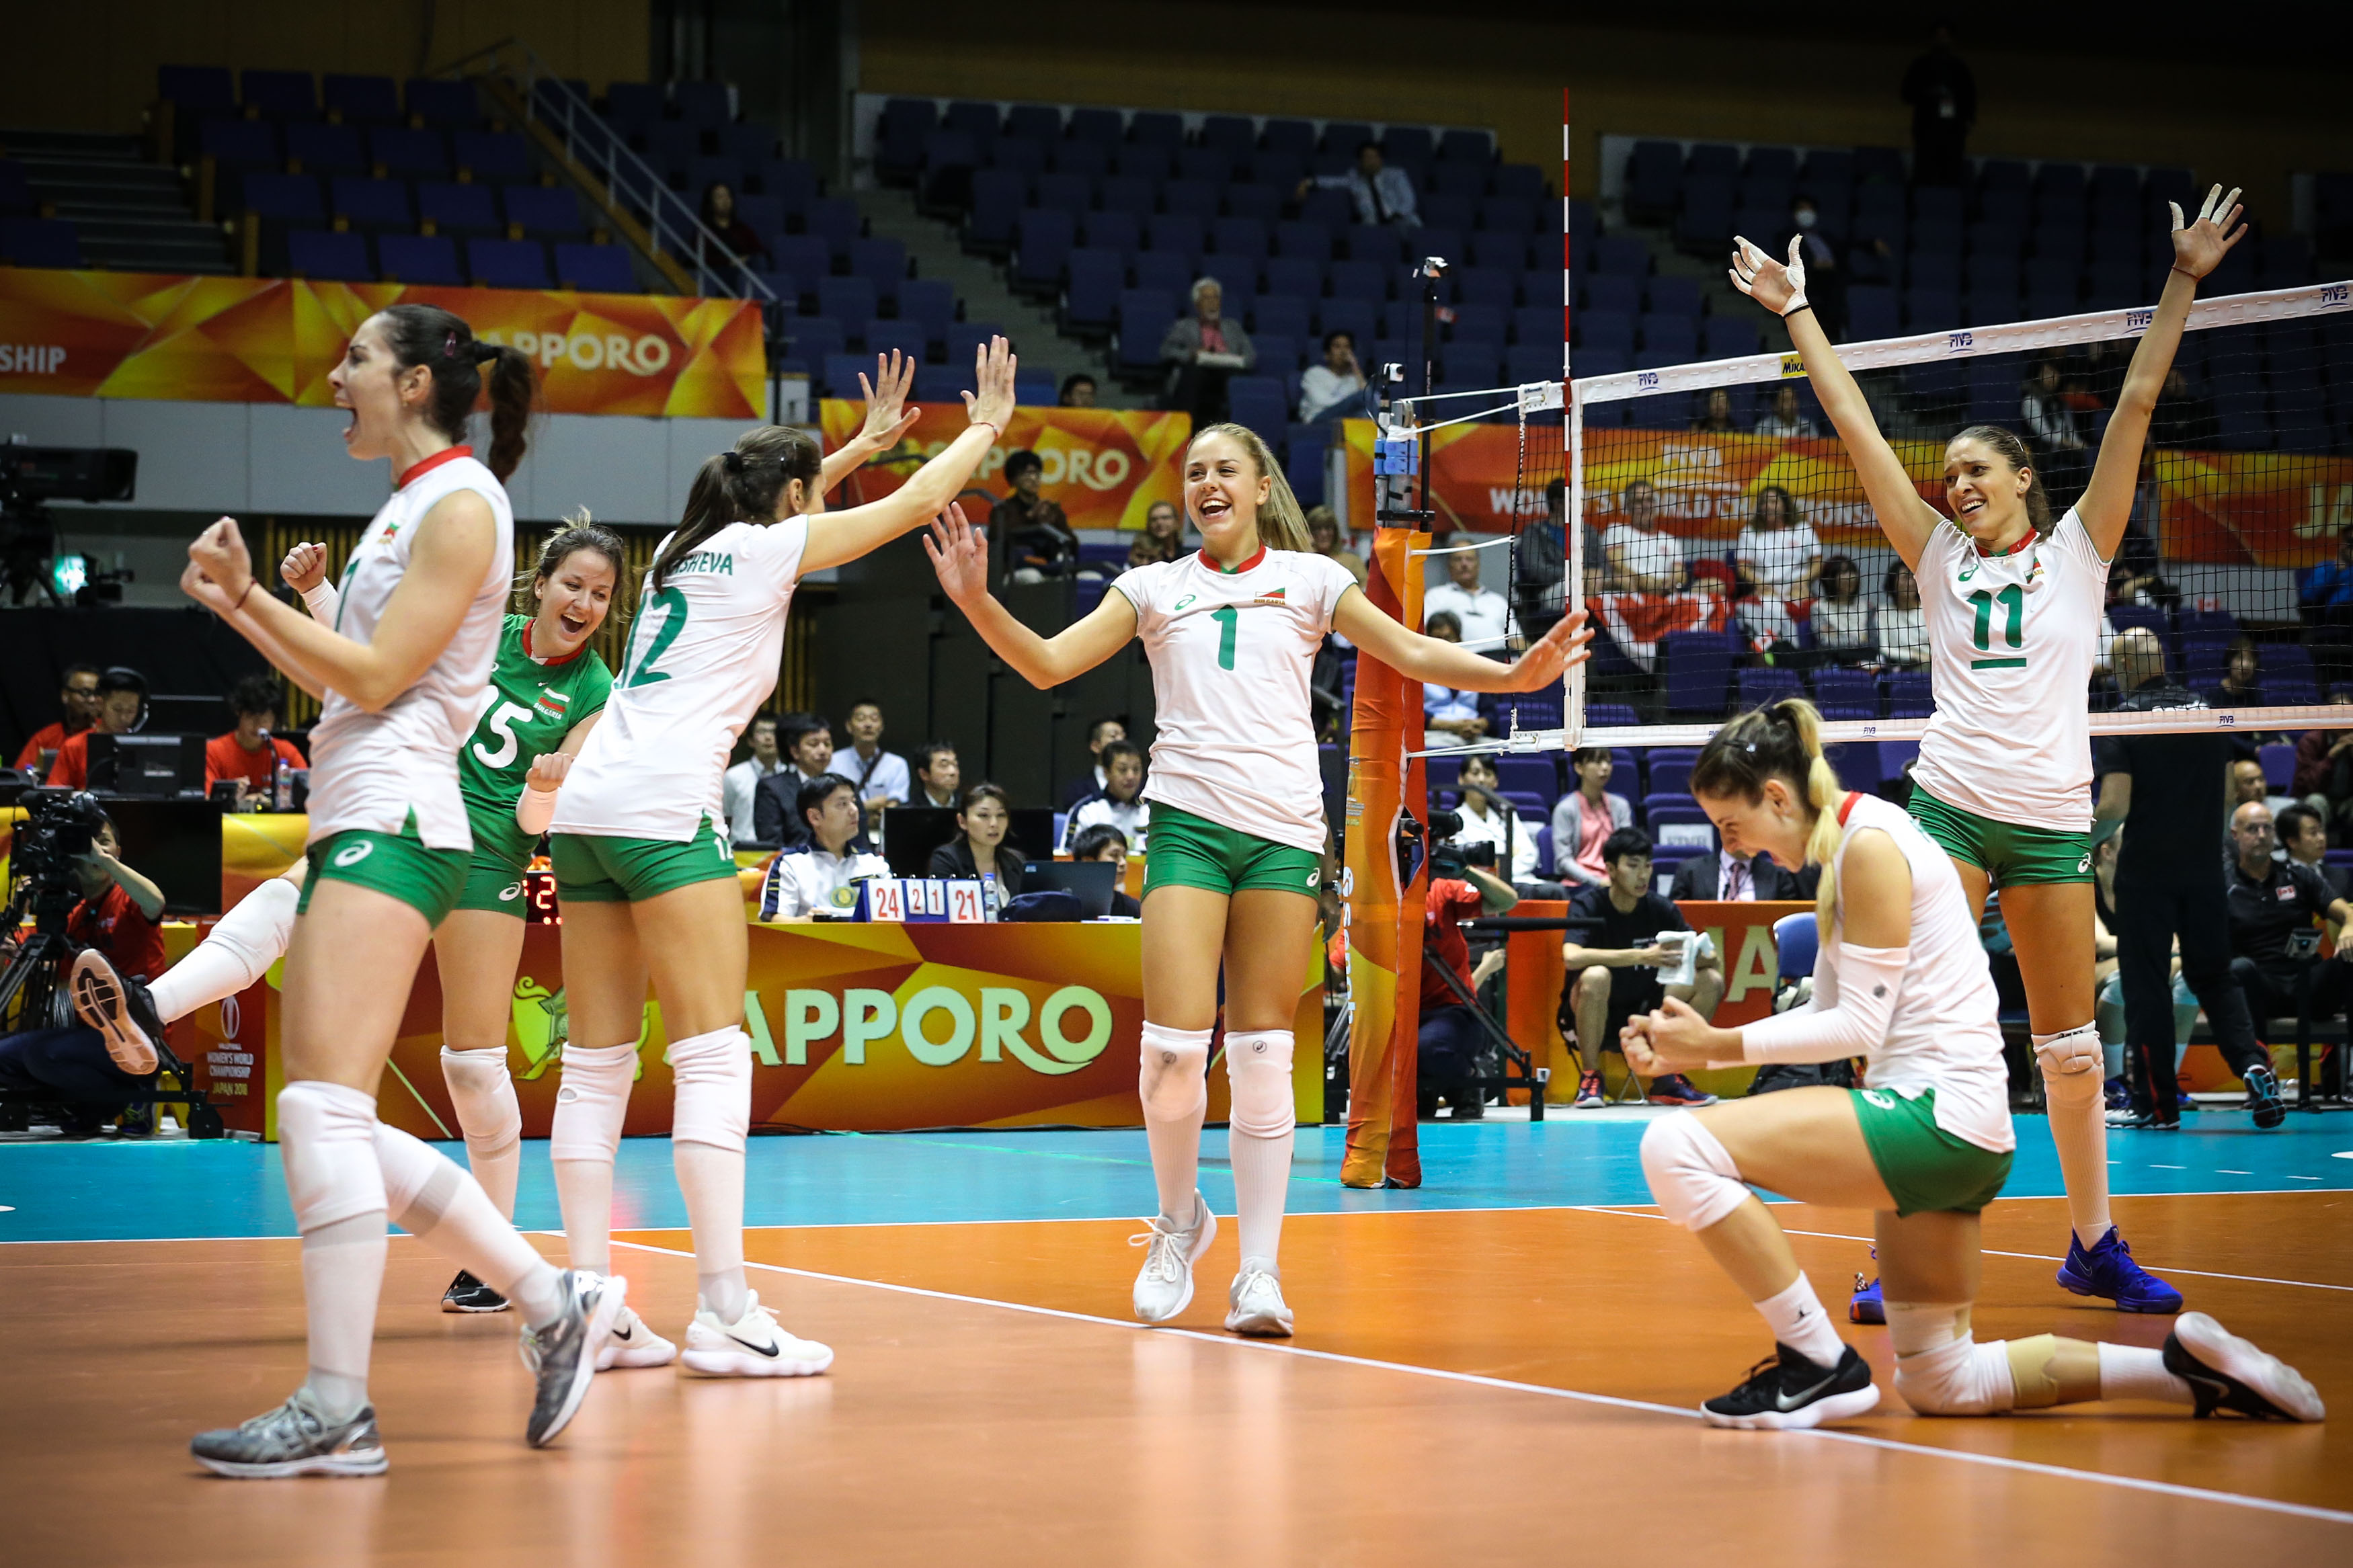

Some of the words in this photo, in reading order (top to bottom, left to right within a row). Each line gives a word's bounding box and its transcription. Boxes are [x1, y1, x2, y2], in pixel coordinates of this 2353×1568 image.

[0, 345, 67, 373] SHIP
[1782, 358, 1806, 374] MIKA
[1966, 583, 2023, 651] 11
[1210, 604, 1238, 671] 1
[533, 702, 562, 720] BULGARIA
[876, 888, 899, 917] 24
[912, 889, 921, 910] 2
[932, 889, 939, 911] 1
[955, 890, 977, 920] 21
